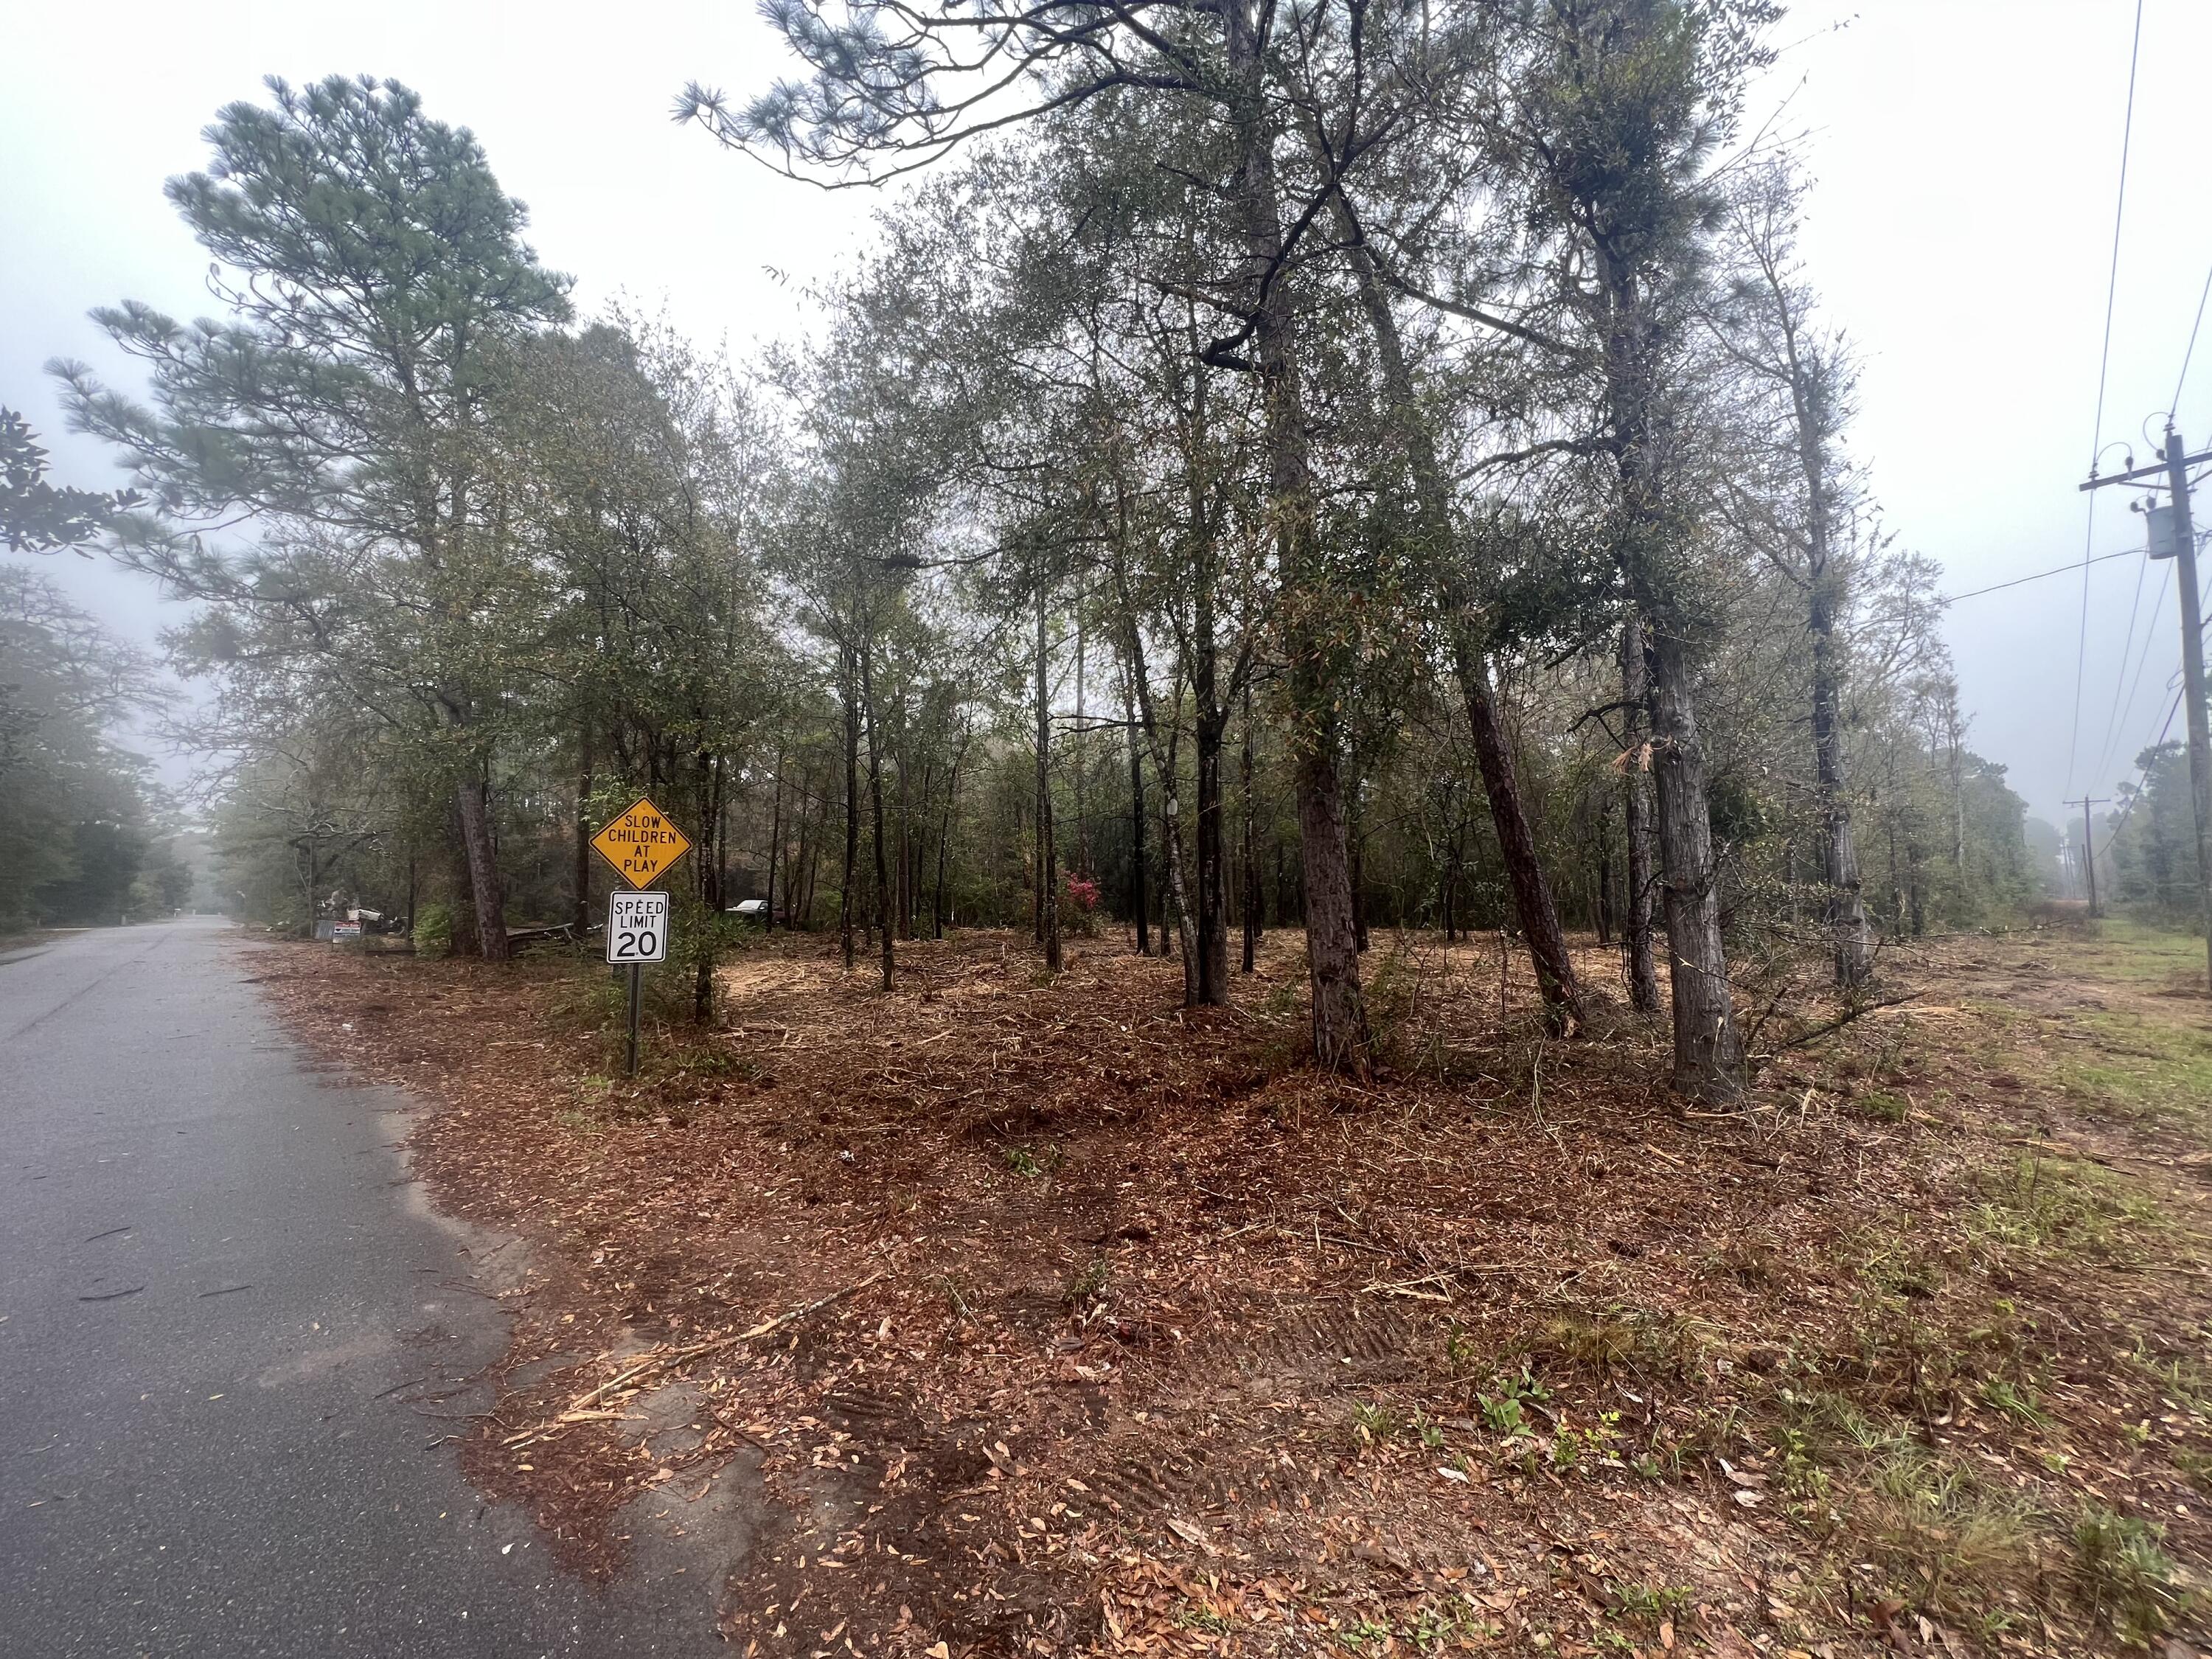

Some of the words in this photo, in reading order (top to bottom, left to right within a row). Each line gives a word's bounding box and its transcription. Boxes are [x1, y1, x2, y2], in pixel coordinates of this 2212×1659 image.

[625, 815, 661, 828] SLOW
[608, 830, 676, 844] CHILDREN
[634, 845, 650, 858] AT
[624, 860, 658, 872] PLAY
[615, 901, 664, 914] SPEED
[620, 915, 657, 928] LIMIT
[616, 931, 656, 957] 20
